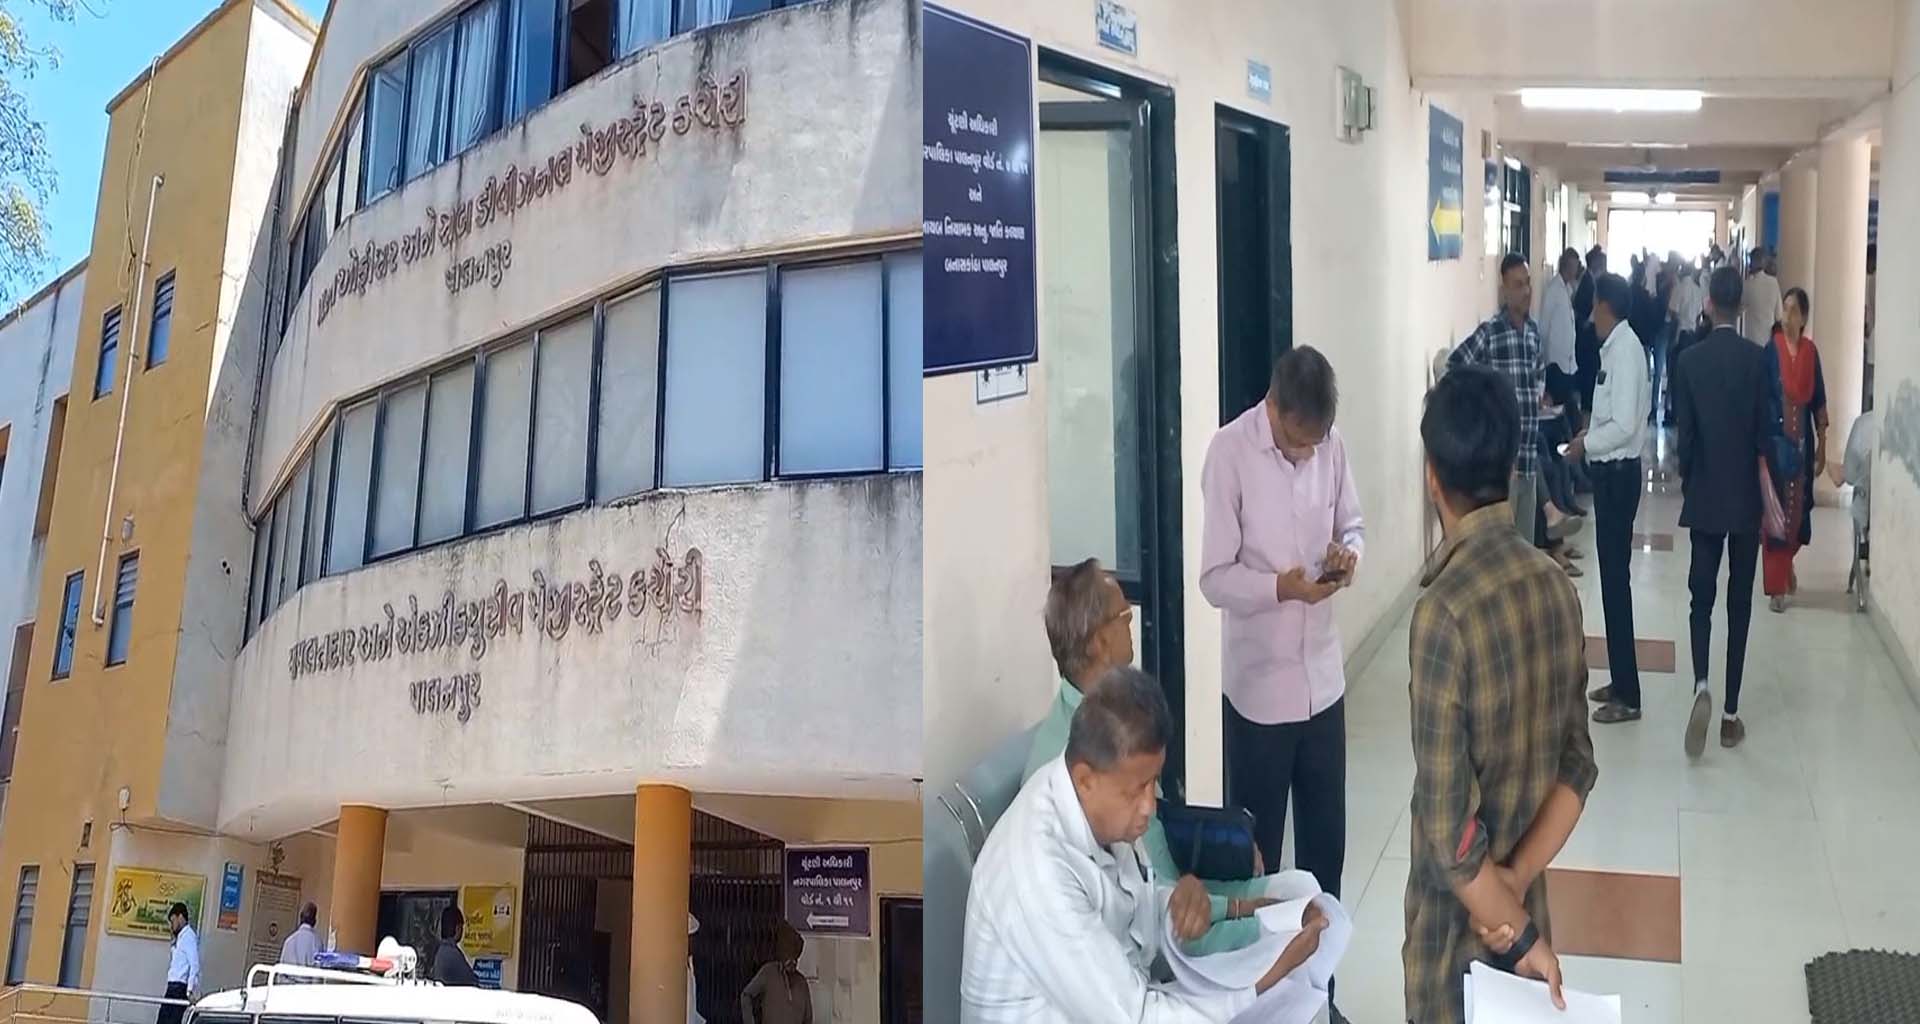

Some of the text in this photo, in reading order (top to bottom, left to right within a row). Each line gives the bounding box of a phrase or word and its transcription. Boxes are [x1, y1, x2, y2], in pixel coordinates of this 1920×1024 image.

[947, 107, 998, 136] ચૂંટણી અધિકારી
[401, 207, 436, 264] અને
[672, 68, 747, 136] કચેરી
[954, 149, 981, 174] પાલનપુર
[969, 182, 982, 203] અને
[445, 240, 512, 295] પાલનપુર
[944, 253, 1008, 278] બનાસકાંઠા પાલનપુર
[358, 603, 394, 662] અને
[627, 547, 703, 617] કચેરી
[409, 672, 481, 724] પાલનપુર
[801, 855, 853, 872] ચૂંટણી અધિકારી
[793, 874, 863, 892] નગરપાલિકા પાલનપુર
